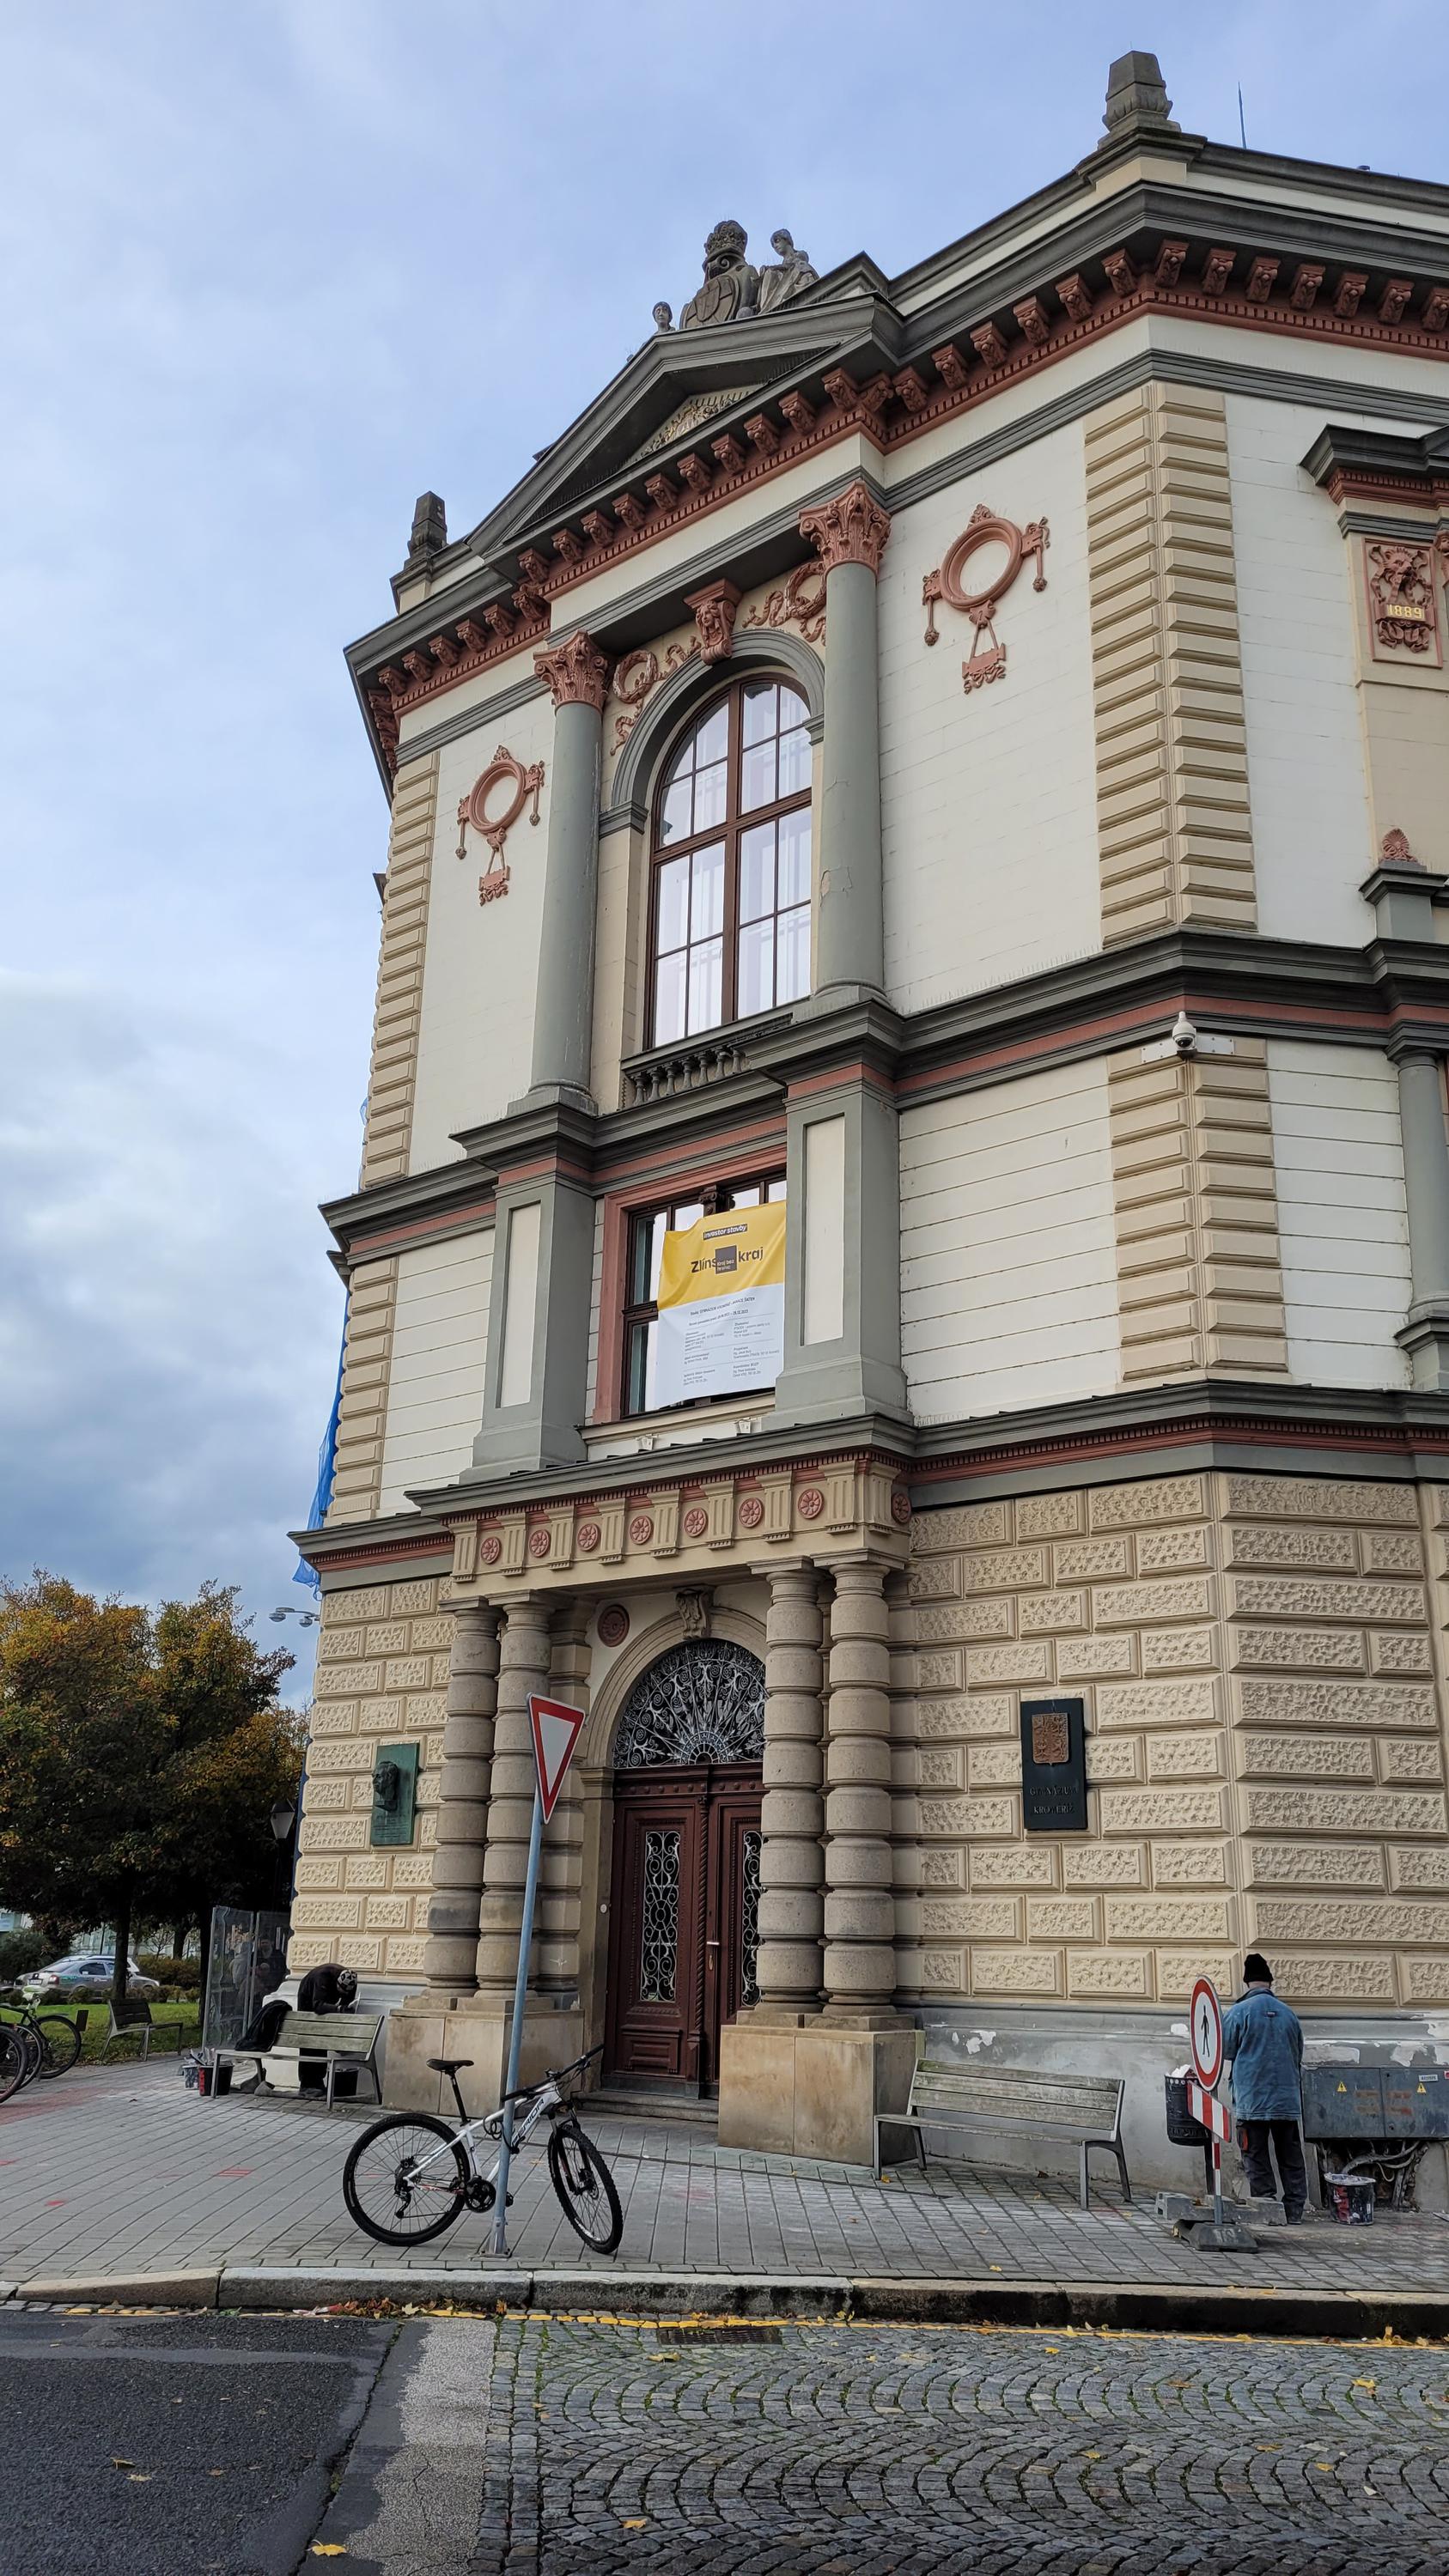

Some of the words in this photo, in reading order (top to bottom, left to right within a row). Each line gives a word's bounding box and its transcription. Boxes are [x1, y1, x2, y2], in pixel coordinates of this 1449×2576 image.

[1389, 605, 1422, 619] 1889
[703, 1229, 726, 1239] investor
[727, 1224, 747, 1234] stavby
[739, 1247, 764, 1261] kraj
